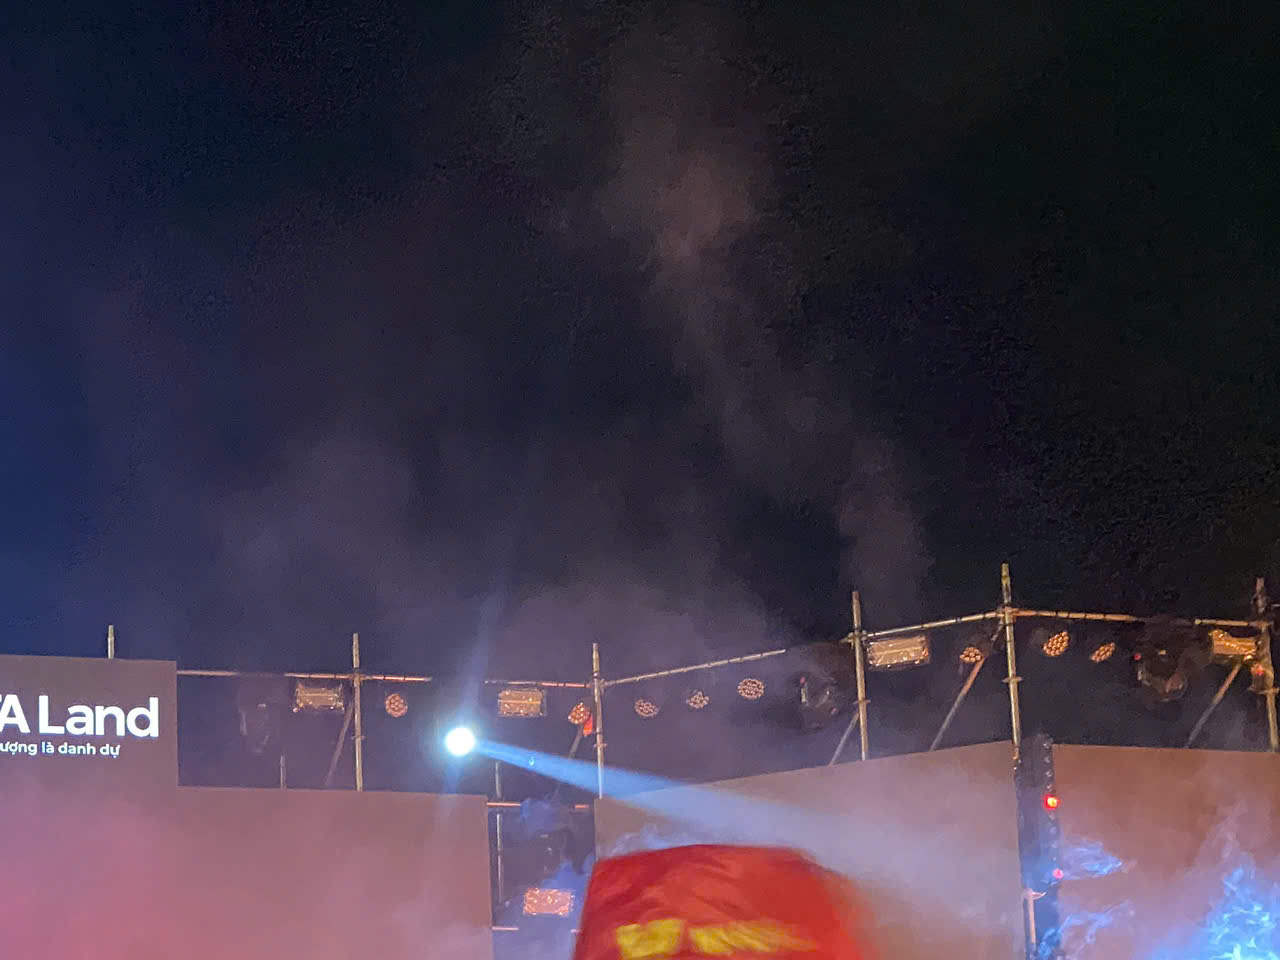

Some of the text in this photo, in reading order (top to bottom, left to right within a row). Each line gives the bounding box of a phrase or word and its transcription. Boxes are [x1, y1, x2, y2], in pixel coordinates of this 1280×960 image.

[38, 695, 159, 738] Land
[41, 741, 55, 754] là
[58, 742, 96, 755] danh
[99, 744, 121, 758] dự
